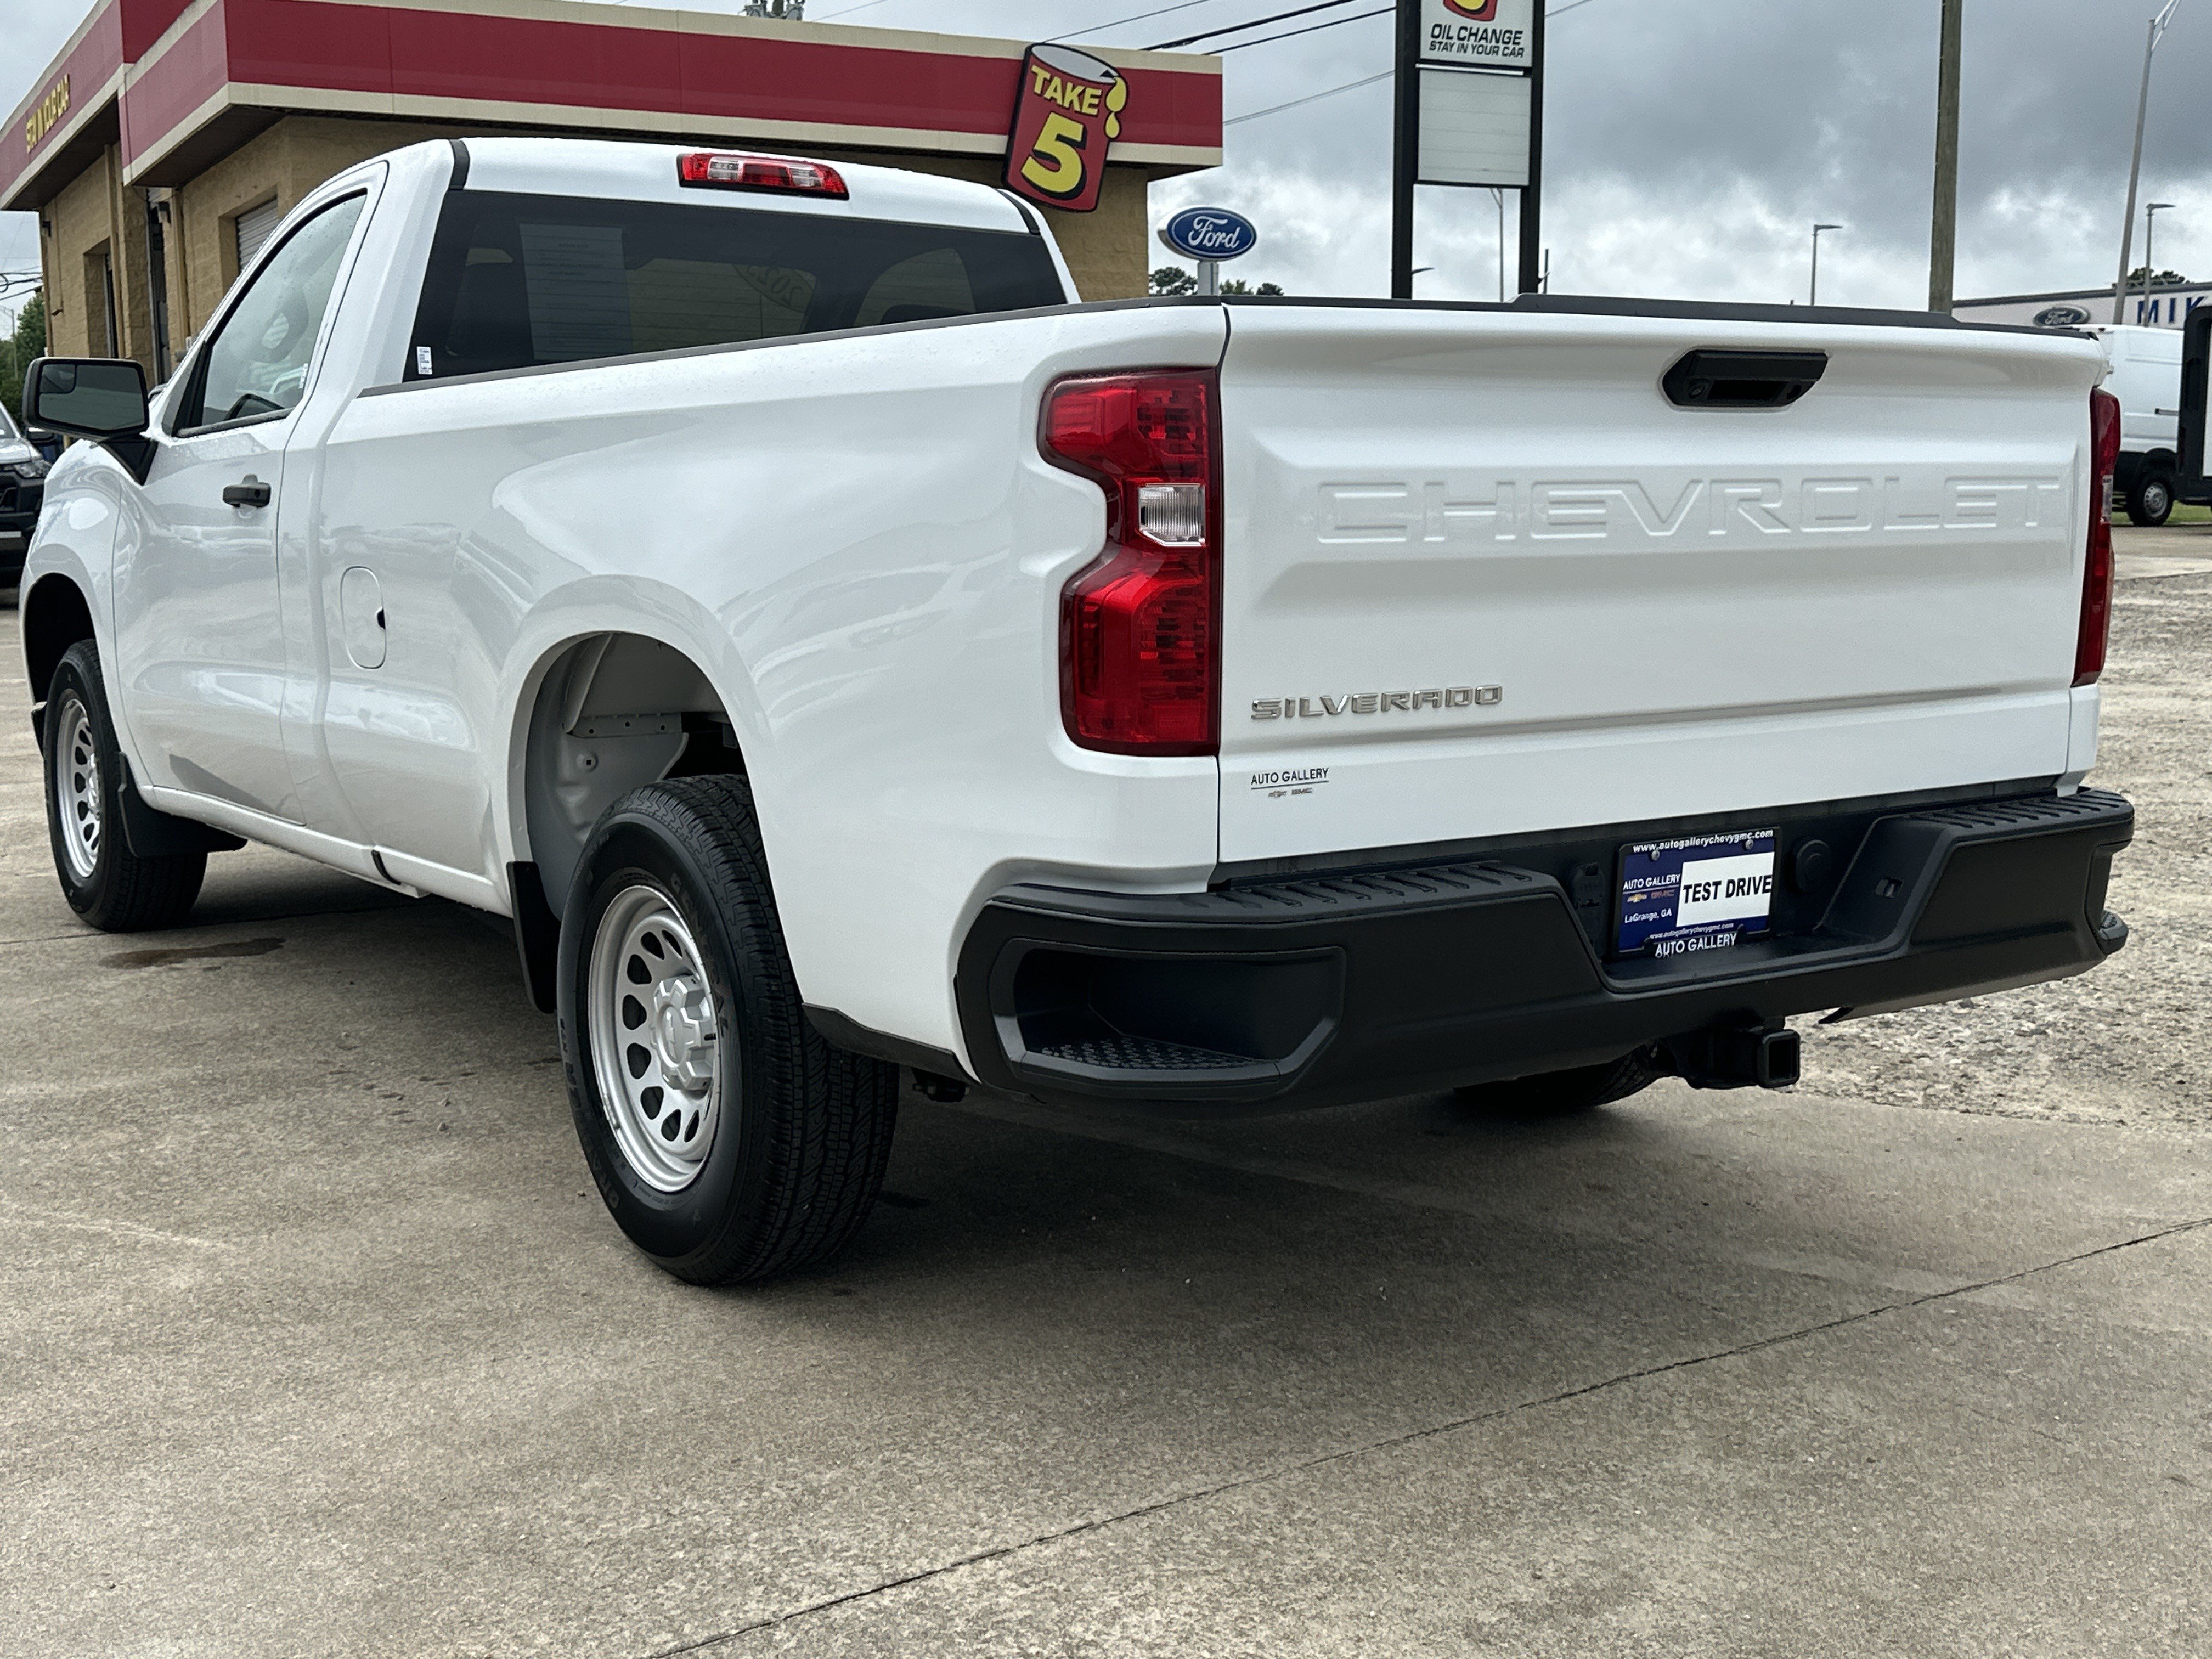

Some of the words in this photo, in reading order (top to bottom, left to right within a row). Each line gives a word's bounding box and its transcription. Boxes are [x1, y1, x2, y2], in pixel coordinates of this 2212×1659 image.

[1431, 24, 1453, 40] OIL
[1457, 26, 1523, 46] CHANGE
[1429, 41, 1455, 52] STAY
[1457, 43, 1469, 54] IN
[1471, 44, 1500, 57] YOUR
[1502, 47, 1525, 58] CAR
[1031, 65, 1103, 116] TAKE
[1021, 112, 1086, 196] 5
[1188, 216, 1241, 249] Ford
[1318, 476, 2059, 543] CHEVROLET
[1251, 684, 1503, 720] SILVERADO
[1251, 771, 1279, 785] AUTO
[1282, 768, 1329, 782] GALLERY
[1633, 830, 1774, 853] www.autogallerychevygmc.com
[1623, 879, 1644, 890] AUTO
[1645, 873, 1681, 887] GALLERY
[1683, 880, 1722, 904] TEST
[1725, 875, 1773, 898] DRIVE
[1625, 911, 1660, 923] LaGrange,
[1661, 909, 1672, 917] GA
[1655, 940, 1684, 956] AUTO
[1688, 933, 1737, 951] GALLERY
